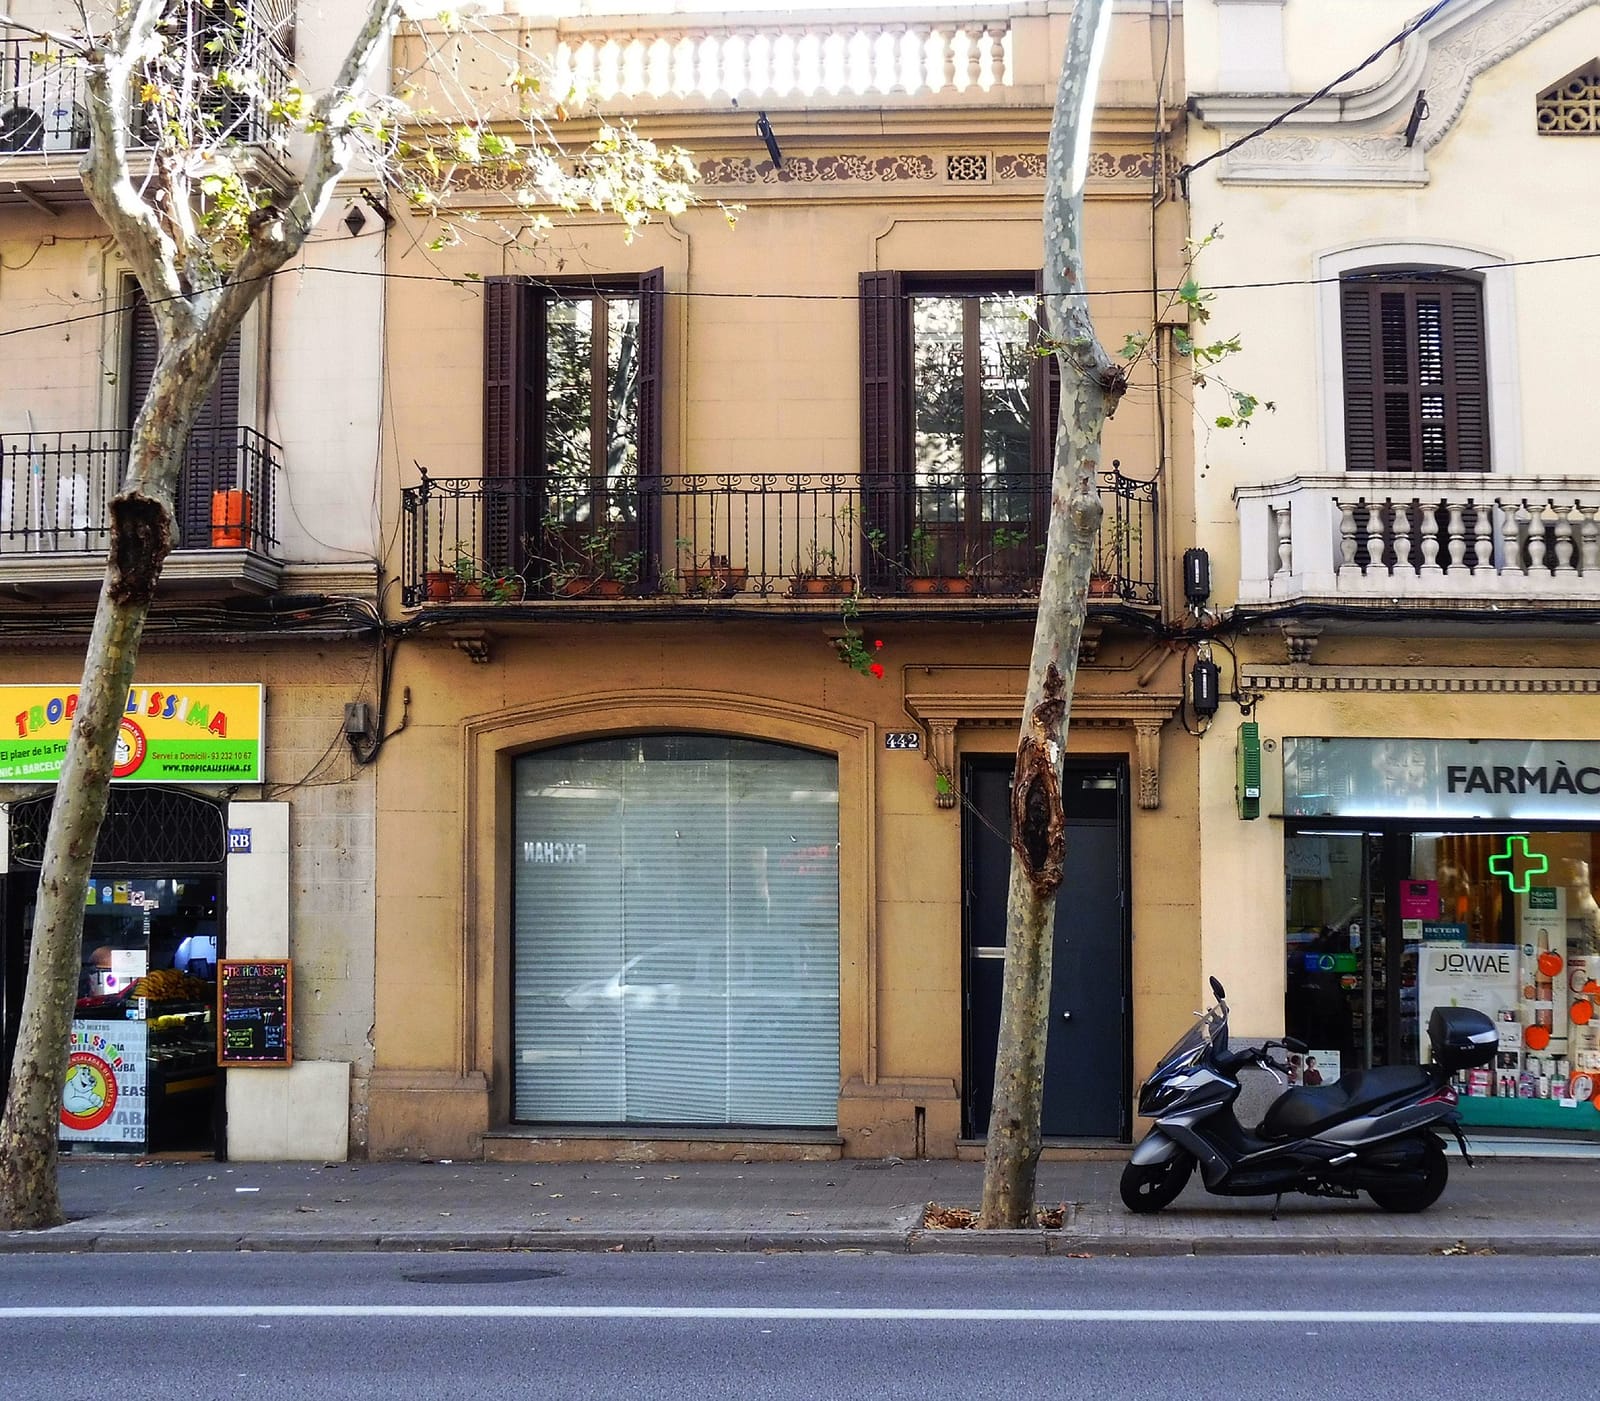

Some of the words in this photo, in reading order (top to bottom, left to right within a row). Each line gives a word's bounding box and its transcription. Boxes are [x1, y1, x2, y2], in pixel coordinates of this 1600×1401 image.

[15, 689, 228, 738] TROPLISSIMA
[886, 733, 918, 748] 442
[1, 751, 8, 760] El
[11, 750, 30, 761] plaer
[32, 747, 42, 756] de
[43, 745, 51, 754] la
[152, 752, 173, 760] Servei
[181, 752, 207, 760] Domicili
[211, 752, 219, 760] 93
[221, 752, 232, 760] 232
[234, 752, 242, 760] 10
[244, 752, 252, 760] 67
[0, 766, 14, 778] NIC
[1447, 760, 1600, 795] FARMÀC
[230, 834, 250, 848] RB
